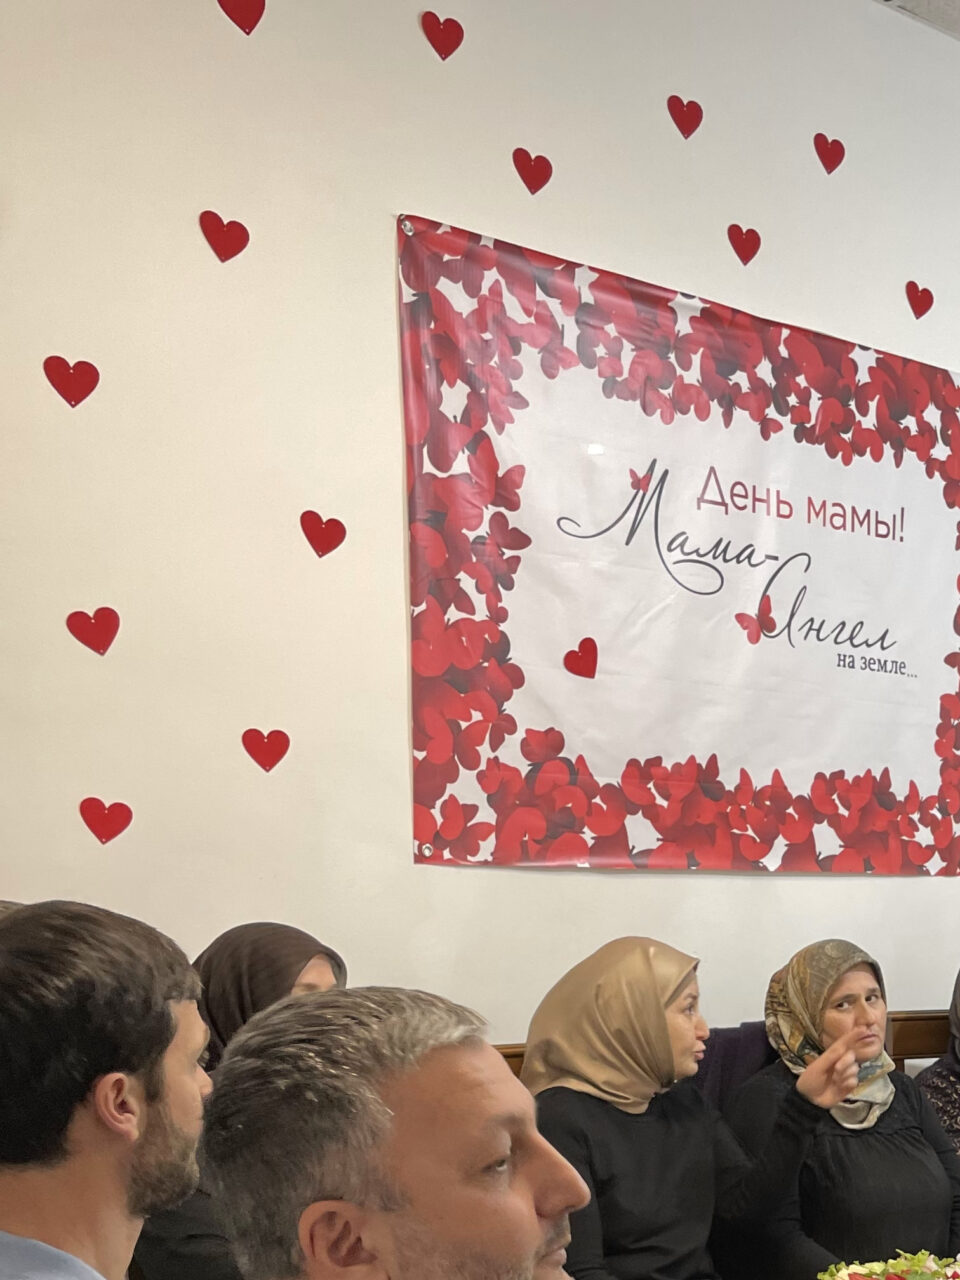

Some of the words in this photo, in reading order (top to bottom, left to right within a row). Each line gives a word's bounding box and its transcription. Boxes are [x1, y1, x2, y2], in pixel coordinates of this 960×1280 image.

[556, 458, 779, 596] Мама-
[696, 465, 794, 520] День
[806, 496, 905, 543] мамы!
[757, 552, 898, 651] Ангел
[836, 653, 856, 669] на
[860, 656, 918, 678] земле...
